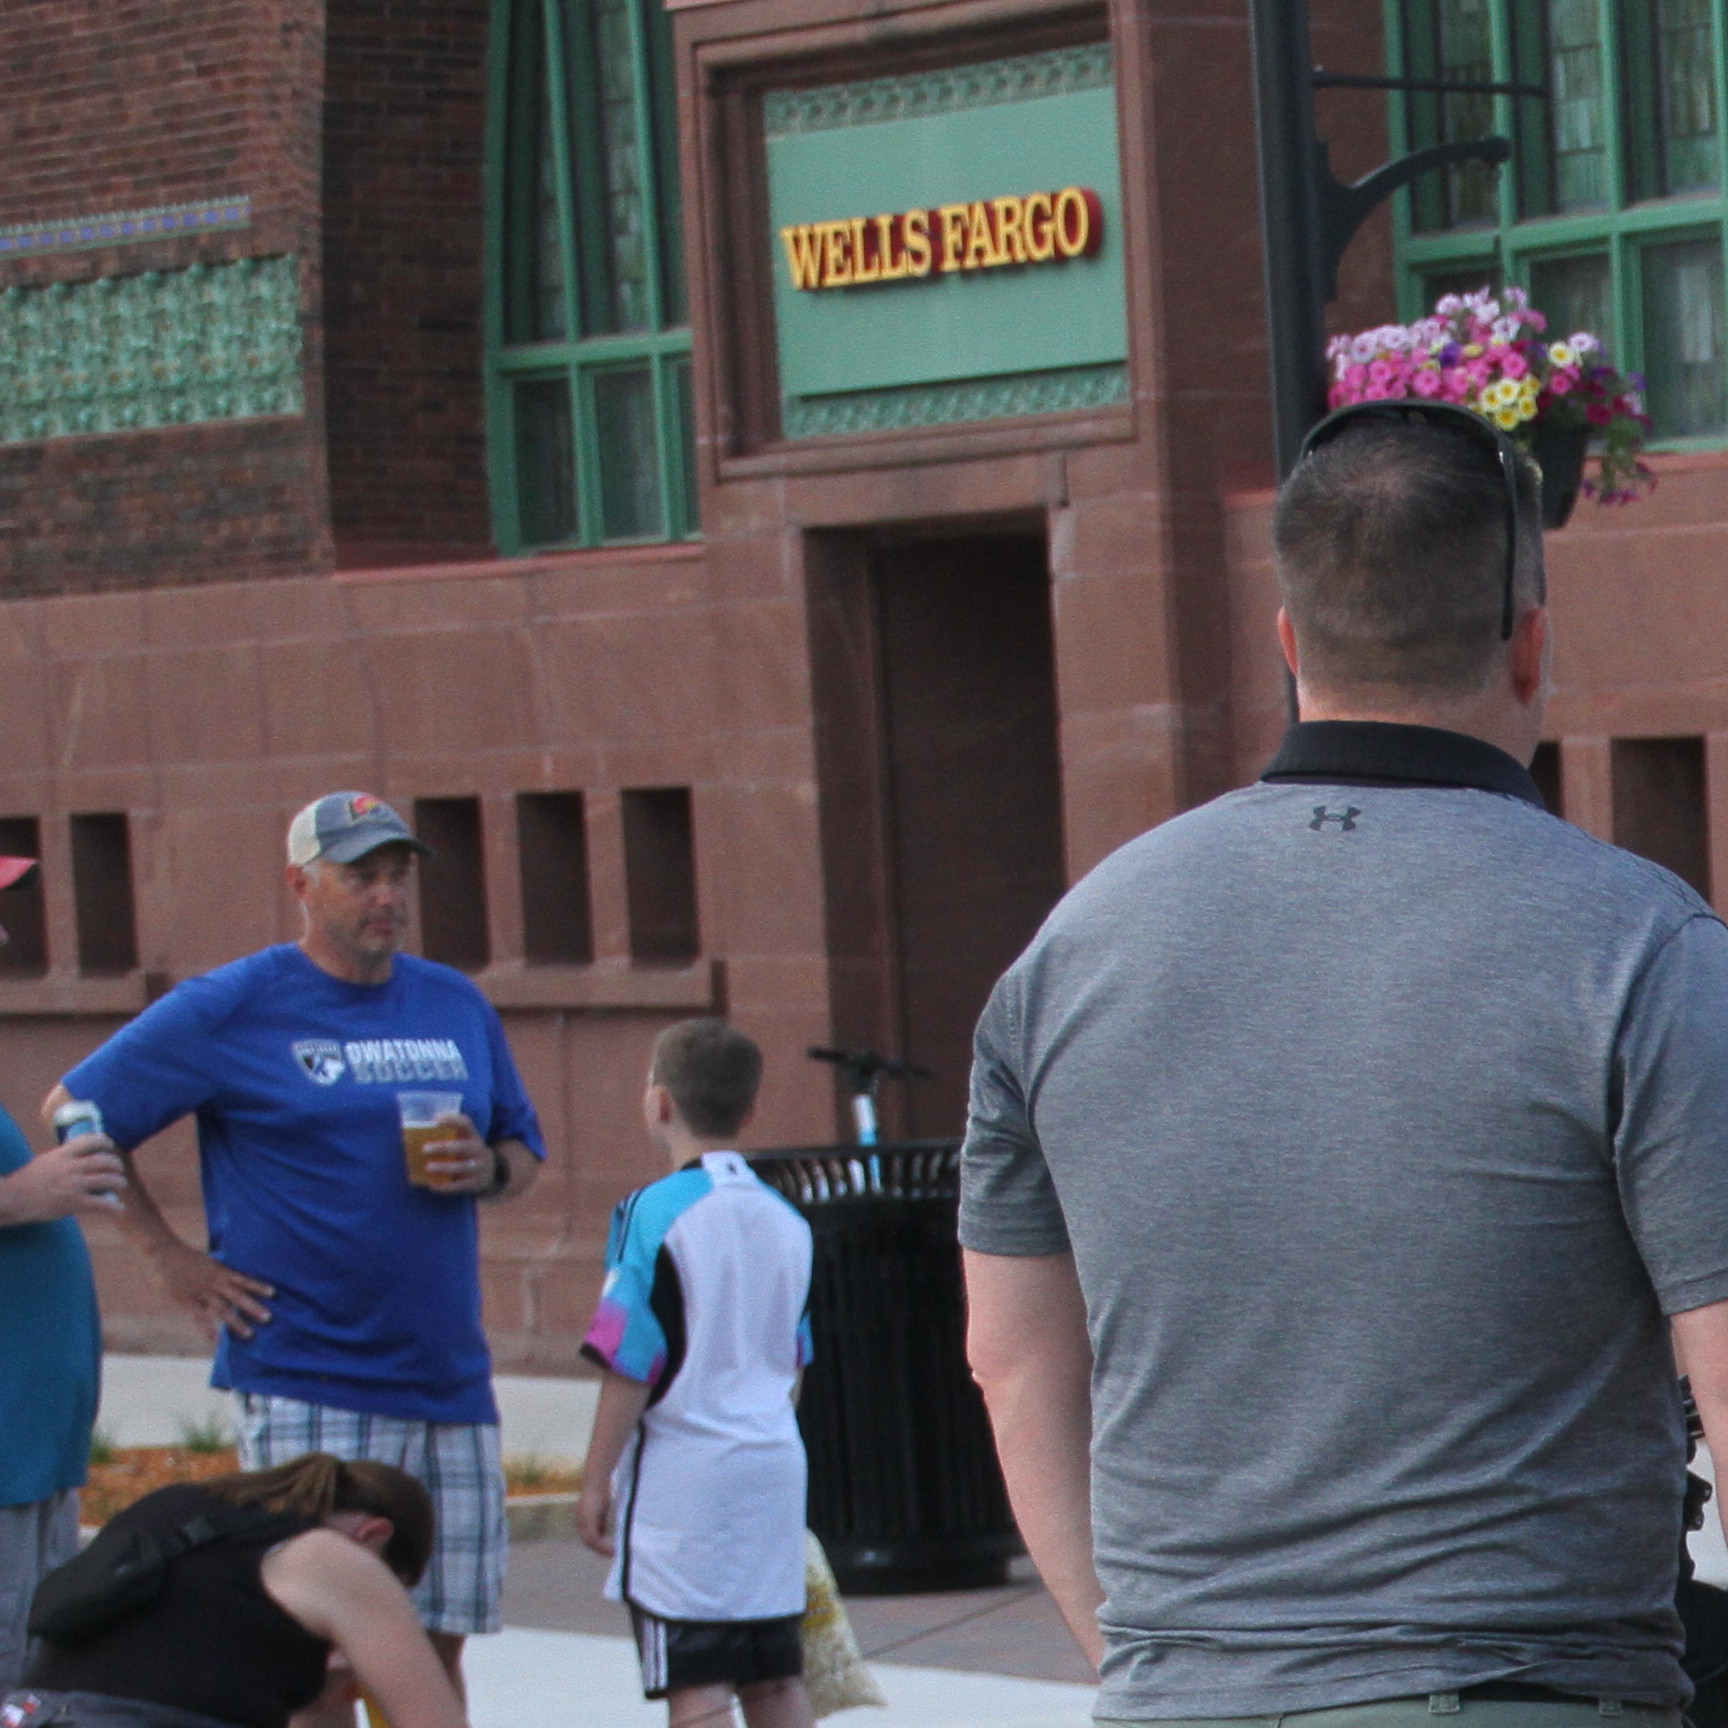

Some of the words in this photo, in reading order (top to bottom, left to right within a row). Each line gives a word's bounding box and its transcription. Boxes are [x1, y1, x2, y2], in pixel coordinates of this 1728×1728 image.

[780, 208, 932, 290] WELLS
[940, 187, 1090, 272] FARGO
[344, 1038, 463, 1064] OWATONNA
